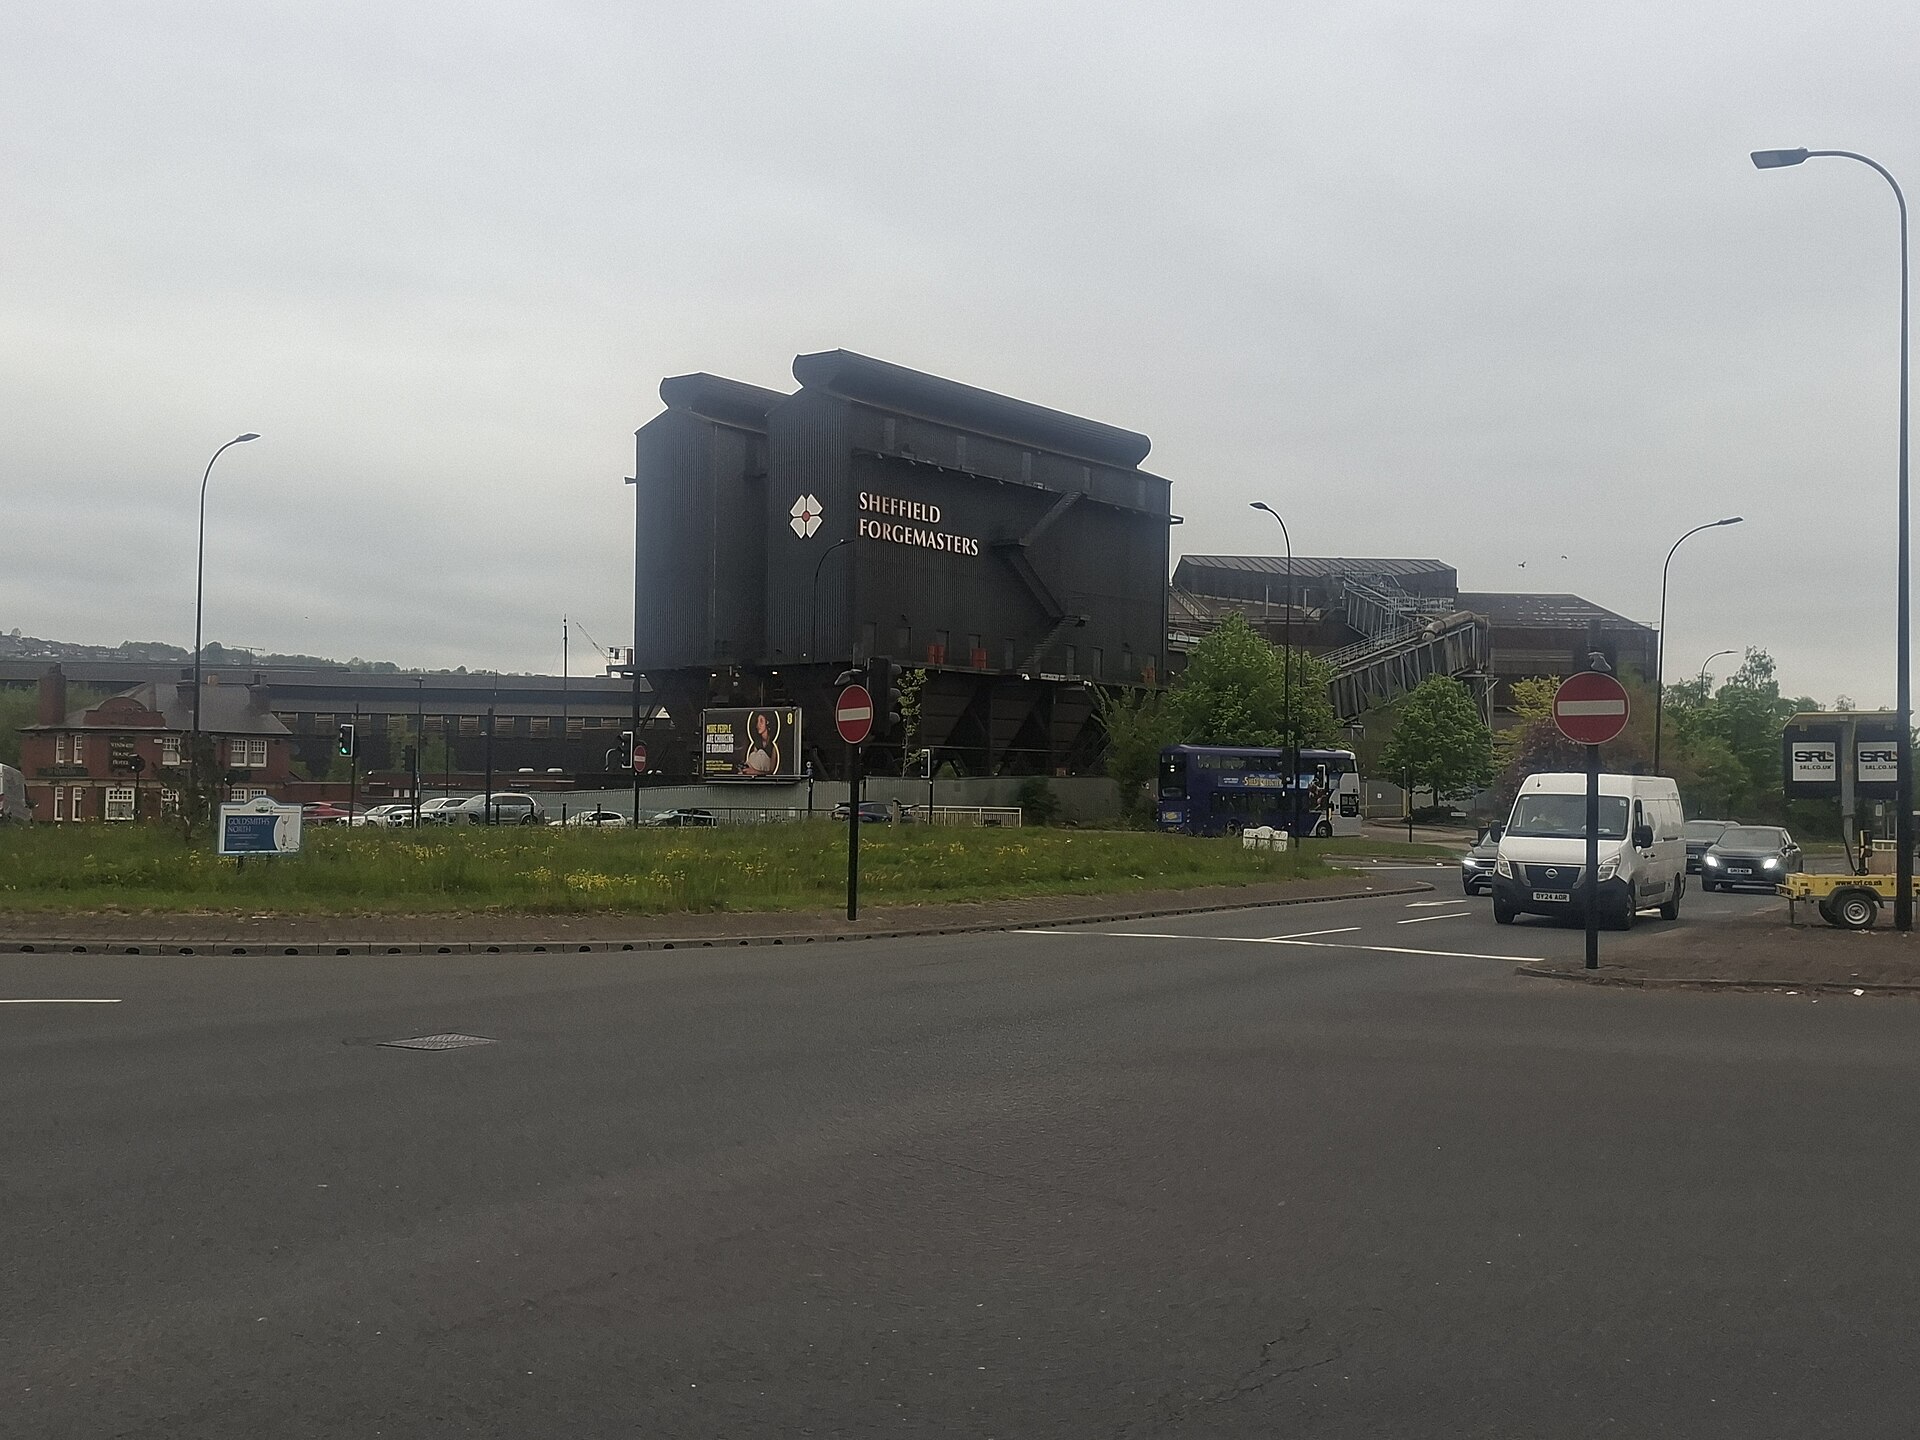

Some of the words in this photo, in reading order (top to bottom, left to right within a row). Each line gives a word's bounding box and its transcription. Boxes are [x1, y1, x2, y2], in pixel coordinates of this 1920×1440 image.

[860, 491, 941, 523] SHEFFIELD
[860, 518, 979, 556] FORGEMASTERS
[1795, 750, 1834, 762] SRL
[1860, 750, 1897, 762] SRL
[227, 817, 271, 826] GOLDSMITHS
[227, 825, 252, 833] NORTH
